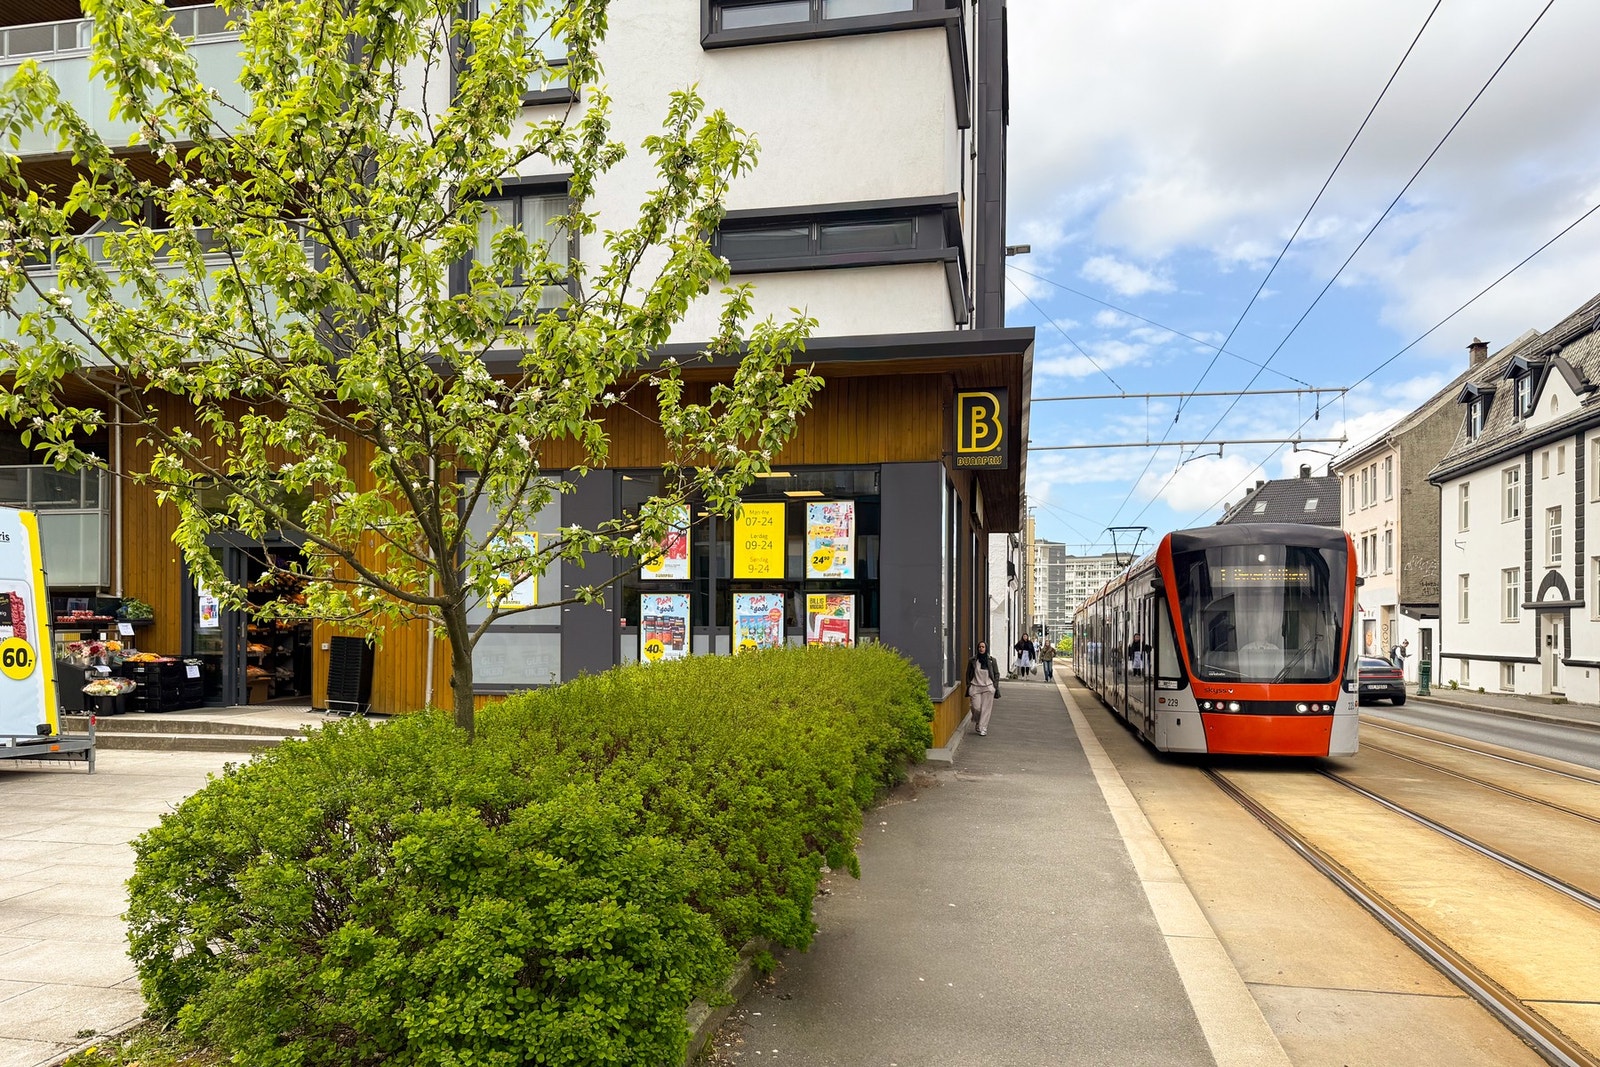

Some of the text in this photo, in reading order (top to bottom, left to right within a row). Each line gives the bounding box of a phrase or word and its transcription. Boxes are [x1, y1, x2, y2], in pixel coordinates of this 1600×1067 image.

[745, 517, 773, 526] 07-24
[745, 540, 773, 550] 09-24
[748, 564, 769, 573] 9-24
[1167, 698, 1178, 707] 229
